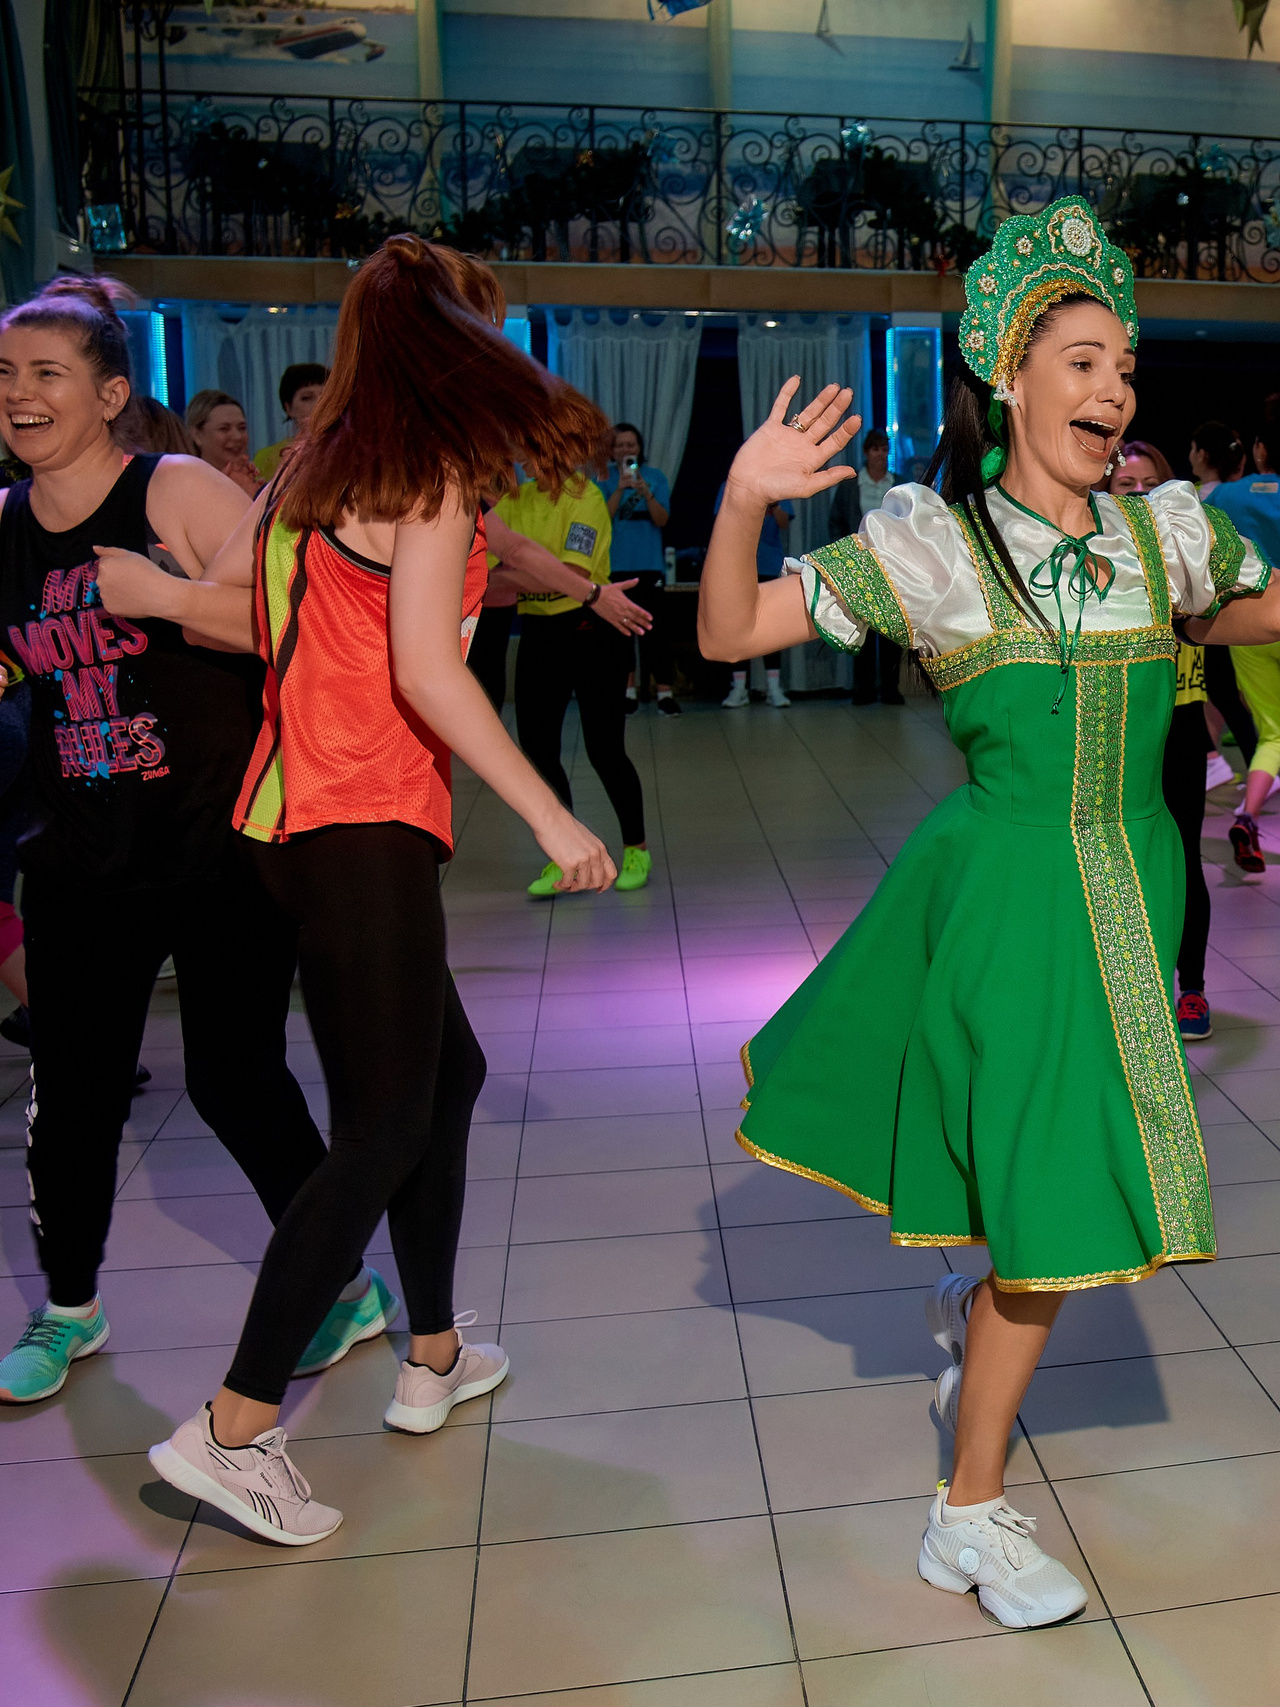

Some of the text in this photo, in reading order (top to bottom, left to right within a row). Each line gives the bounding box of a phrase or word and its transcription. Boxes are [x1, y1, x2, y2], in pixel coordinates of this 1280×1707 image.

[8, 607, 148, 675] MOVES
[62, 664, 119, 721] MY
[54, 712, 165, 778] RULES
[141, 765, 170, 781] ZUMBA
